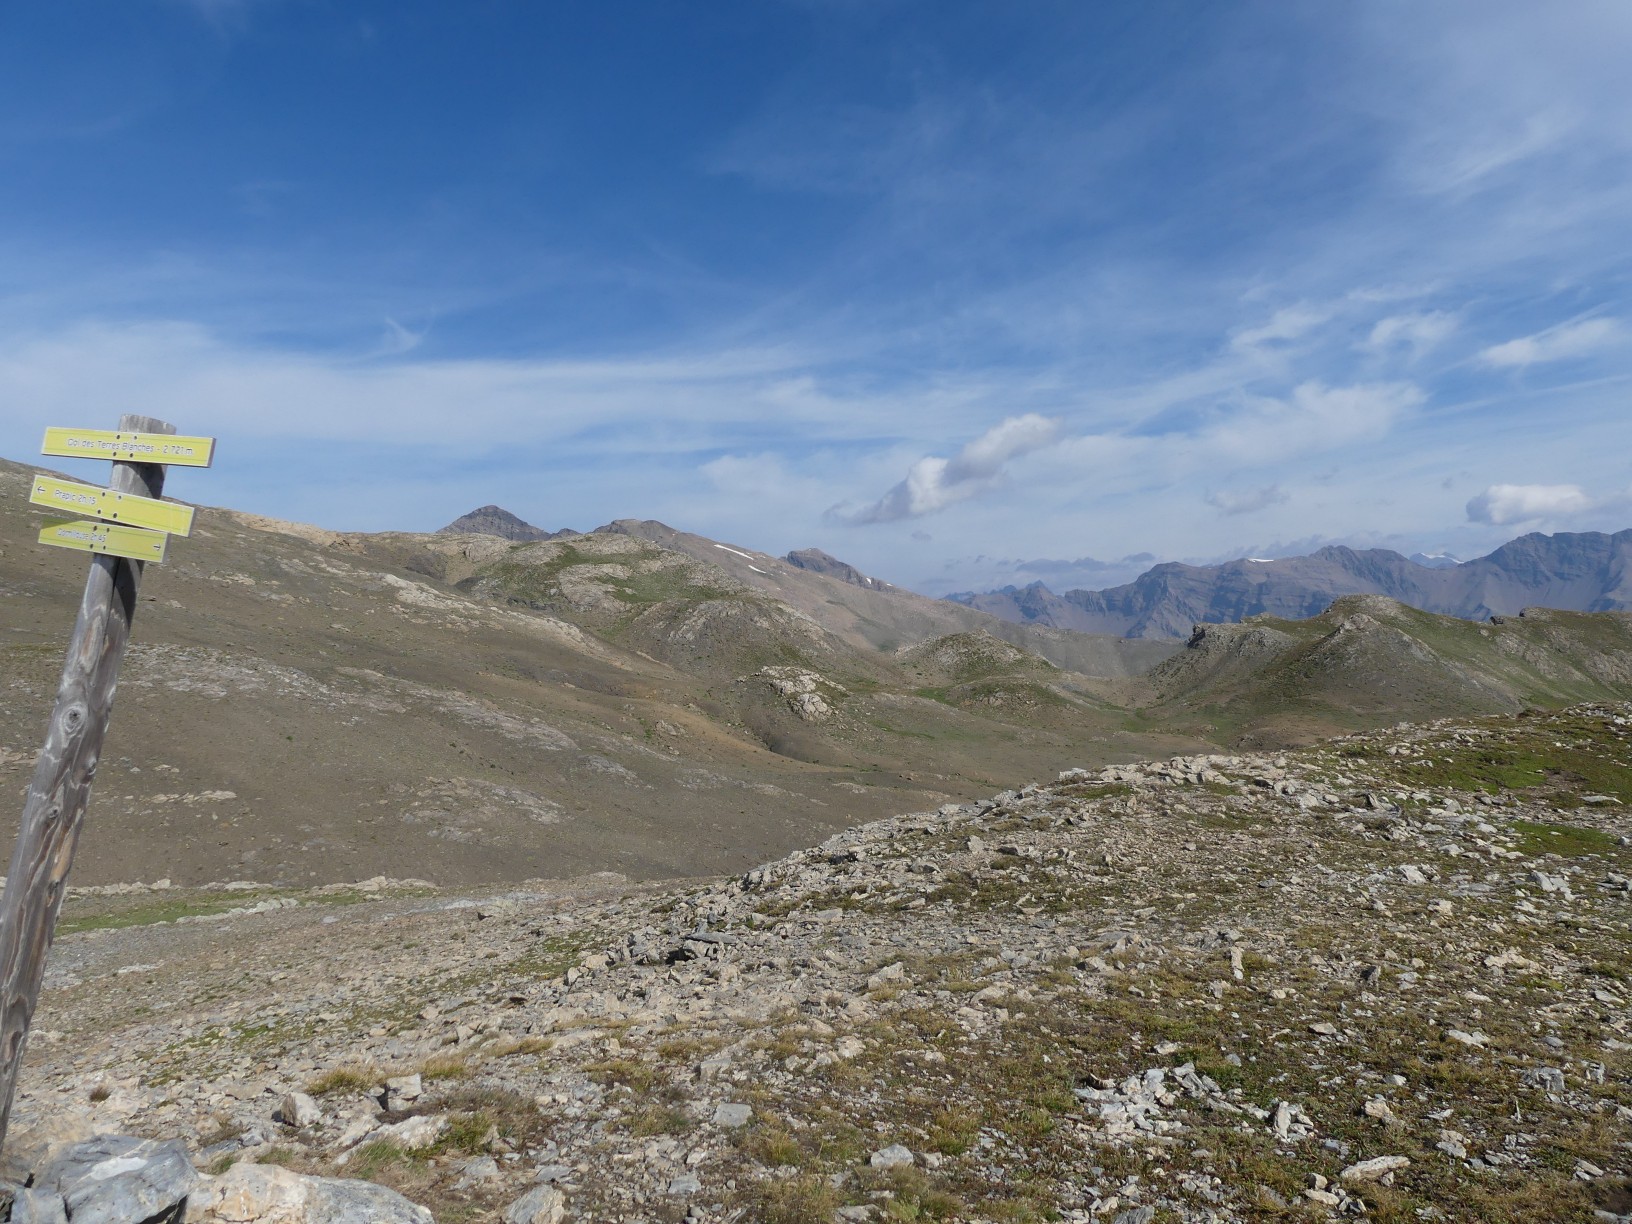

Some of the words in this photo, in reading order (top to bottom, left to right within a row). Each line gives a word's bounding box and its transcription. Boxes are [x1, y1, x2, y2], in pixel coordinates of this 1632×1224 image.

[82, 439, 95, 448] des
[97, 440, 120, 450] Terres
[121, 442, 155, 453] Blanches
